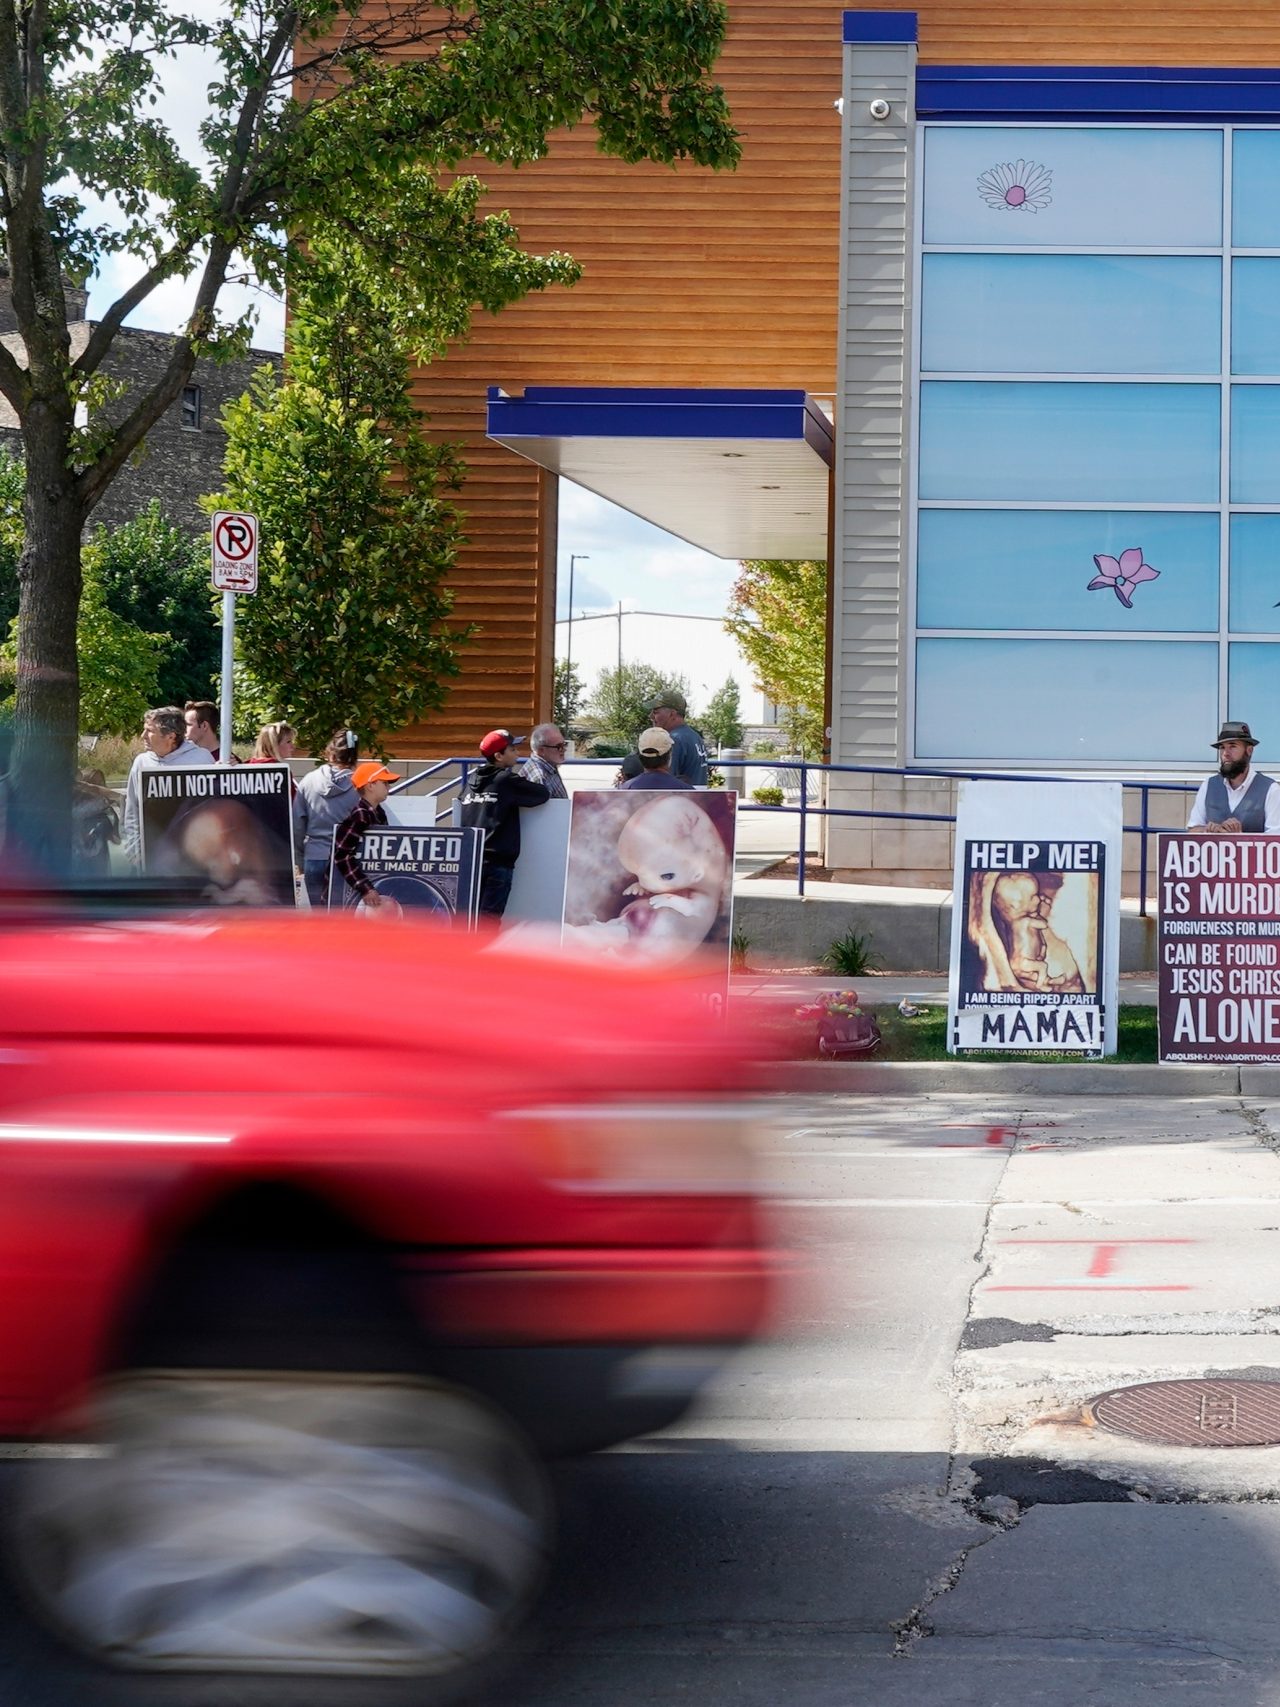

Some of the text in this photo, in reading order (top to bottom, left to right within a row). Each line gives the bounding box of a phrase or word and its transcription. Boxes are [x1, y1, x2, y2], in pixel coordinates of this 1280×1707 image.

[147, 772, 284, 798] AM I NOT HUMAN?
[361, 861, 460, 873] THE IMAGE OF GOD
[971, 843, 1098, 869] HELP ME!
[1163, 882, 1191, 914] IS
[1164, 921, 1234, 936] FORGIVENESS
[1236, 922, 1256, 936] FOR
[1164, 943, 1197, 965] CAN
[1201, 943, 1221, 965] BE
[1226, 944, 1277, 966] FOUND
[1170, 968, 1224, 994] JESUS
[965, 992, 1096, 1005] I AM BEING RIPPED APART
[981, 1010, 1094, 1045] MAMA!
